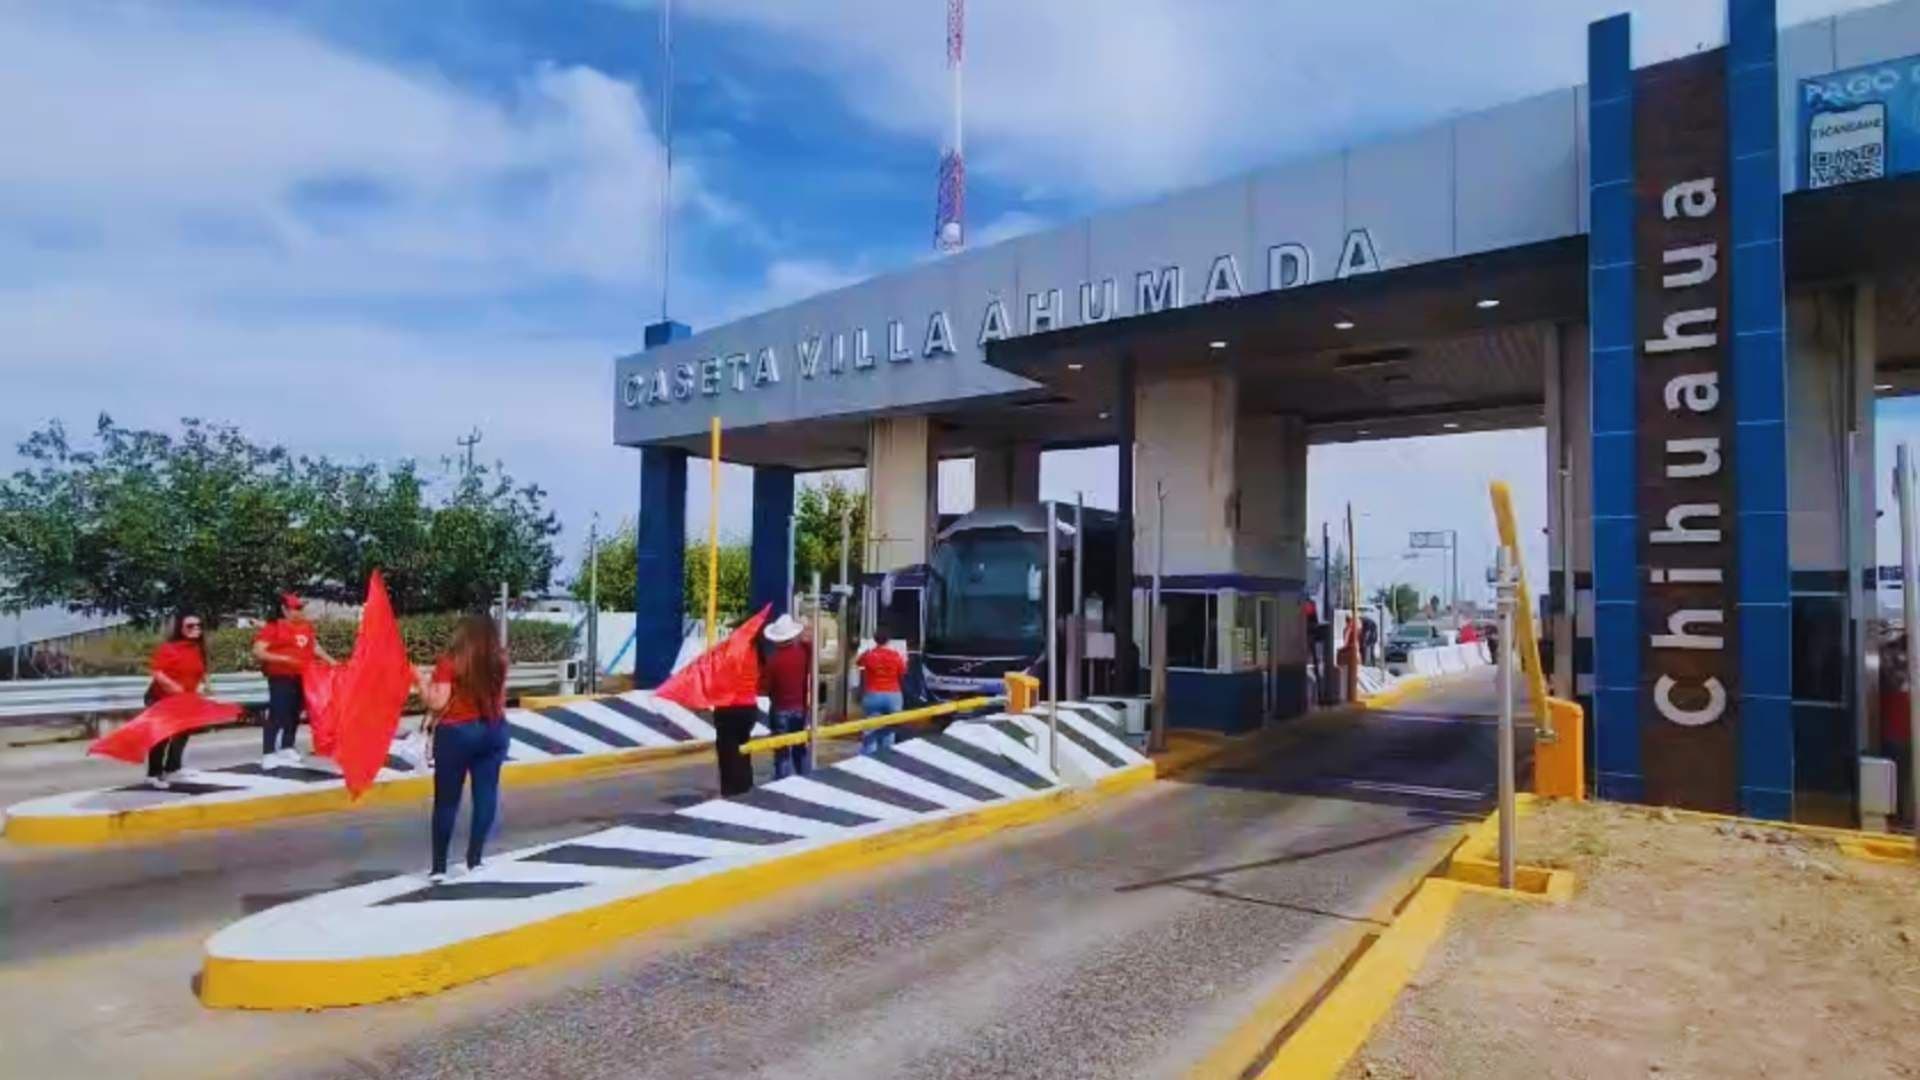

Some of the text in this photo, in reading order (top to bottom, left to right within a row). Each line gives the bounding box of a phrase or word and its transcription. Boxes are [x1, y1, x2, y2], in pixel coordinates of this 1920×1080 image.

[1805, 68, 1899, 108] PAGO
[623, 227, 1381, 408] CASETA VILLA AHUMADA
[1645, 176, 1726, 726] Chihuahua
